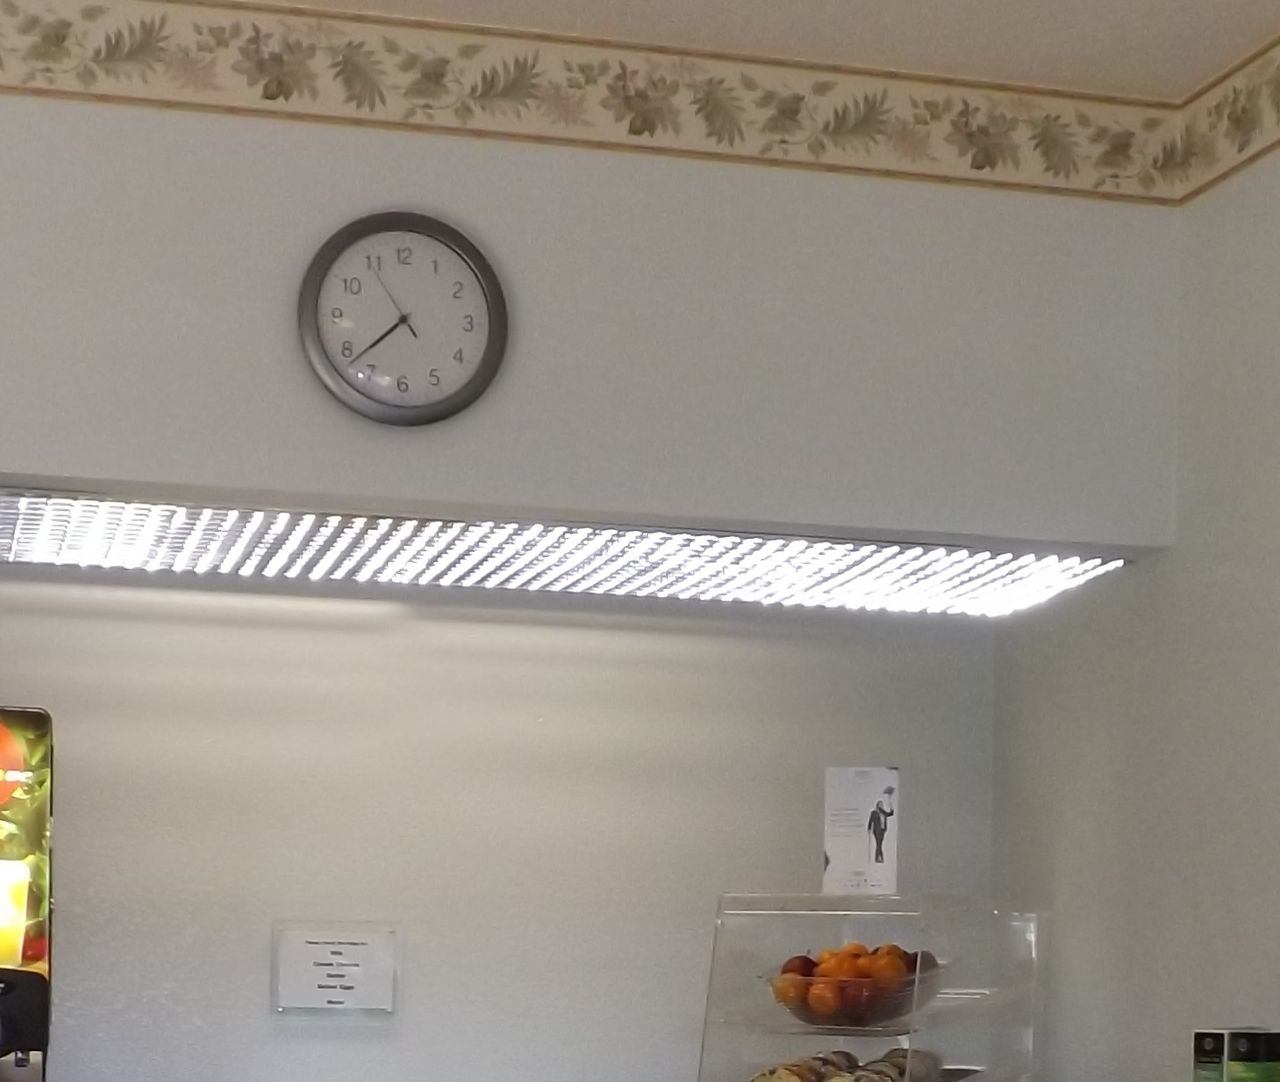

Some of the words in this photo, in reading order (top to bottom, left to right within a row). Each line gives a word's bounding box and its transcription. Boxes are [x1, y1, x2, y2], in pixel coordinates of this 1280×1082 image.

[365, 255, 382, 271] 11
[395, 247, 413, 265] 12
[431, 258, 439, 274] 1
[342, 277, 362, 295] 10
[452, 281, 464, 299] 2
[331, 307, 343, 325] 9
[463, 314, 474, 333] 3
[342, 340, 353, 358] 8
[452, 347, 464, 364] 4
[367, 364, 376, 380] 7
[429, 369, 441, 386] 5
[396, 375, 409, 393] 6
